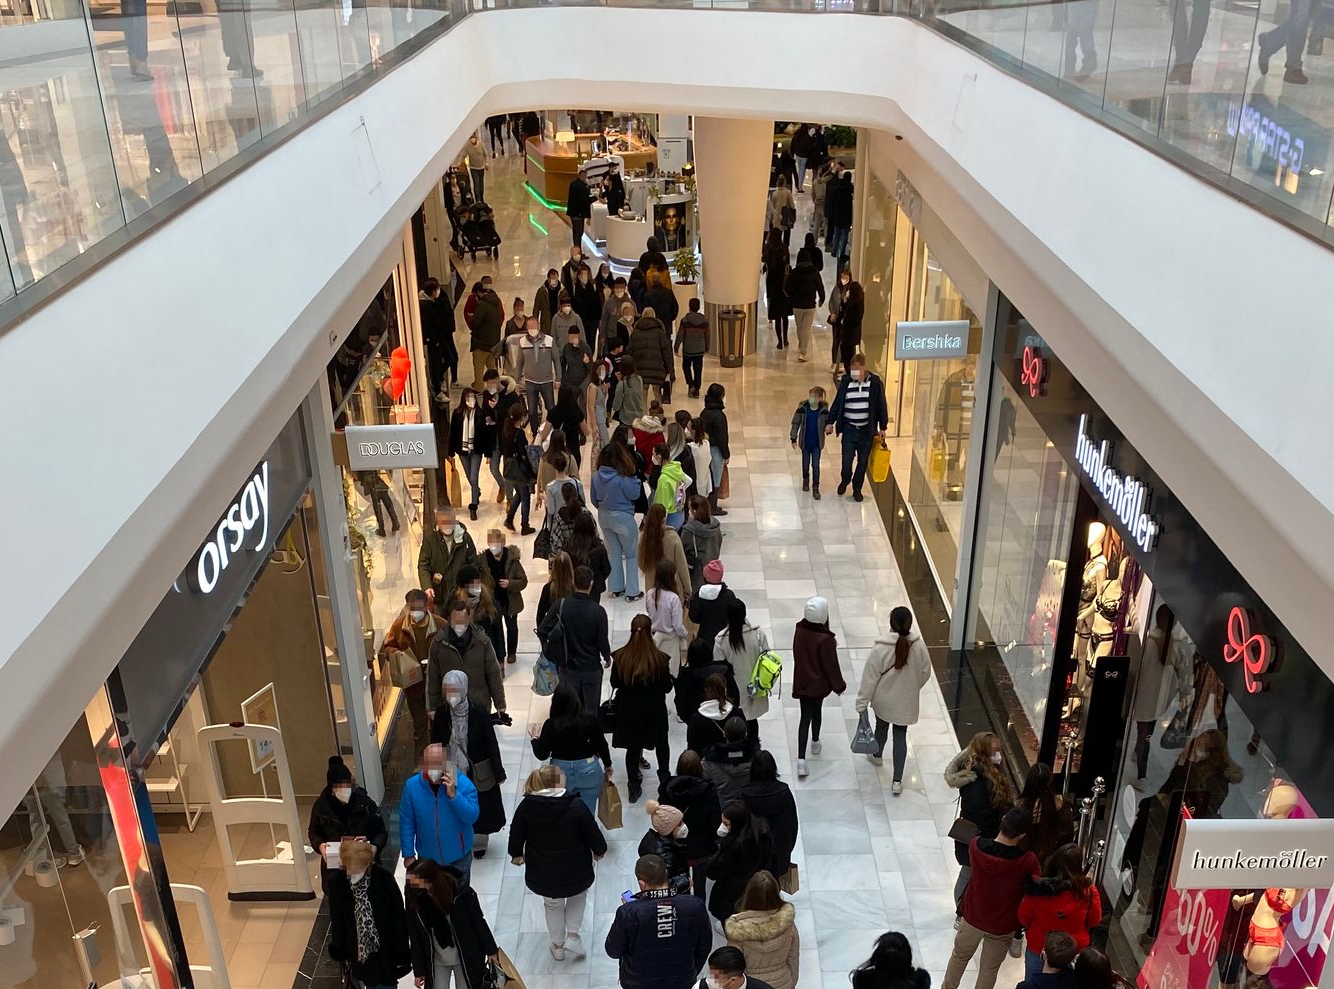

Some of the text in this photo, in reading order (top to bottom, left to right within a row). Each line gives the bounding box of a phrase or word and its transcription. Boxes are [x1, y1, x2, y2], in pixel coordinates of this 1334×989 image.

[902, 333, 962, 351] Bershka
[358, 440, 425, 457] DOUGLAS
[1075, 413, 1155, 553] hunkemöller
[197, 460, 269, 594] orsay
[1192, 848, 1328, 870] hunkemöller
[657, 905, 673, 939] CREW
